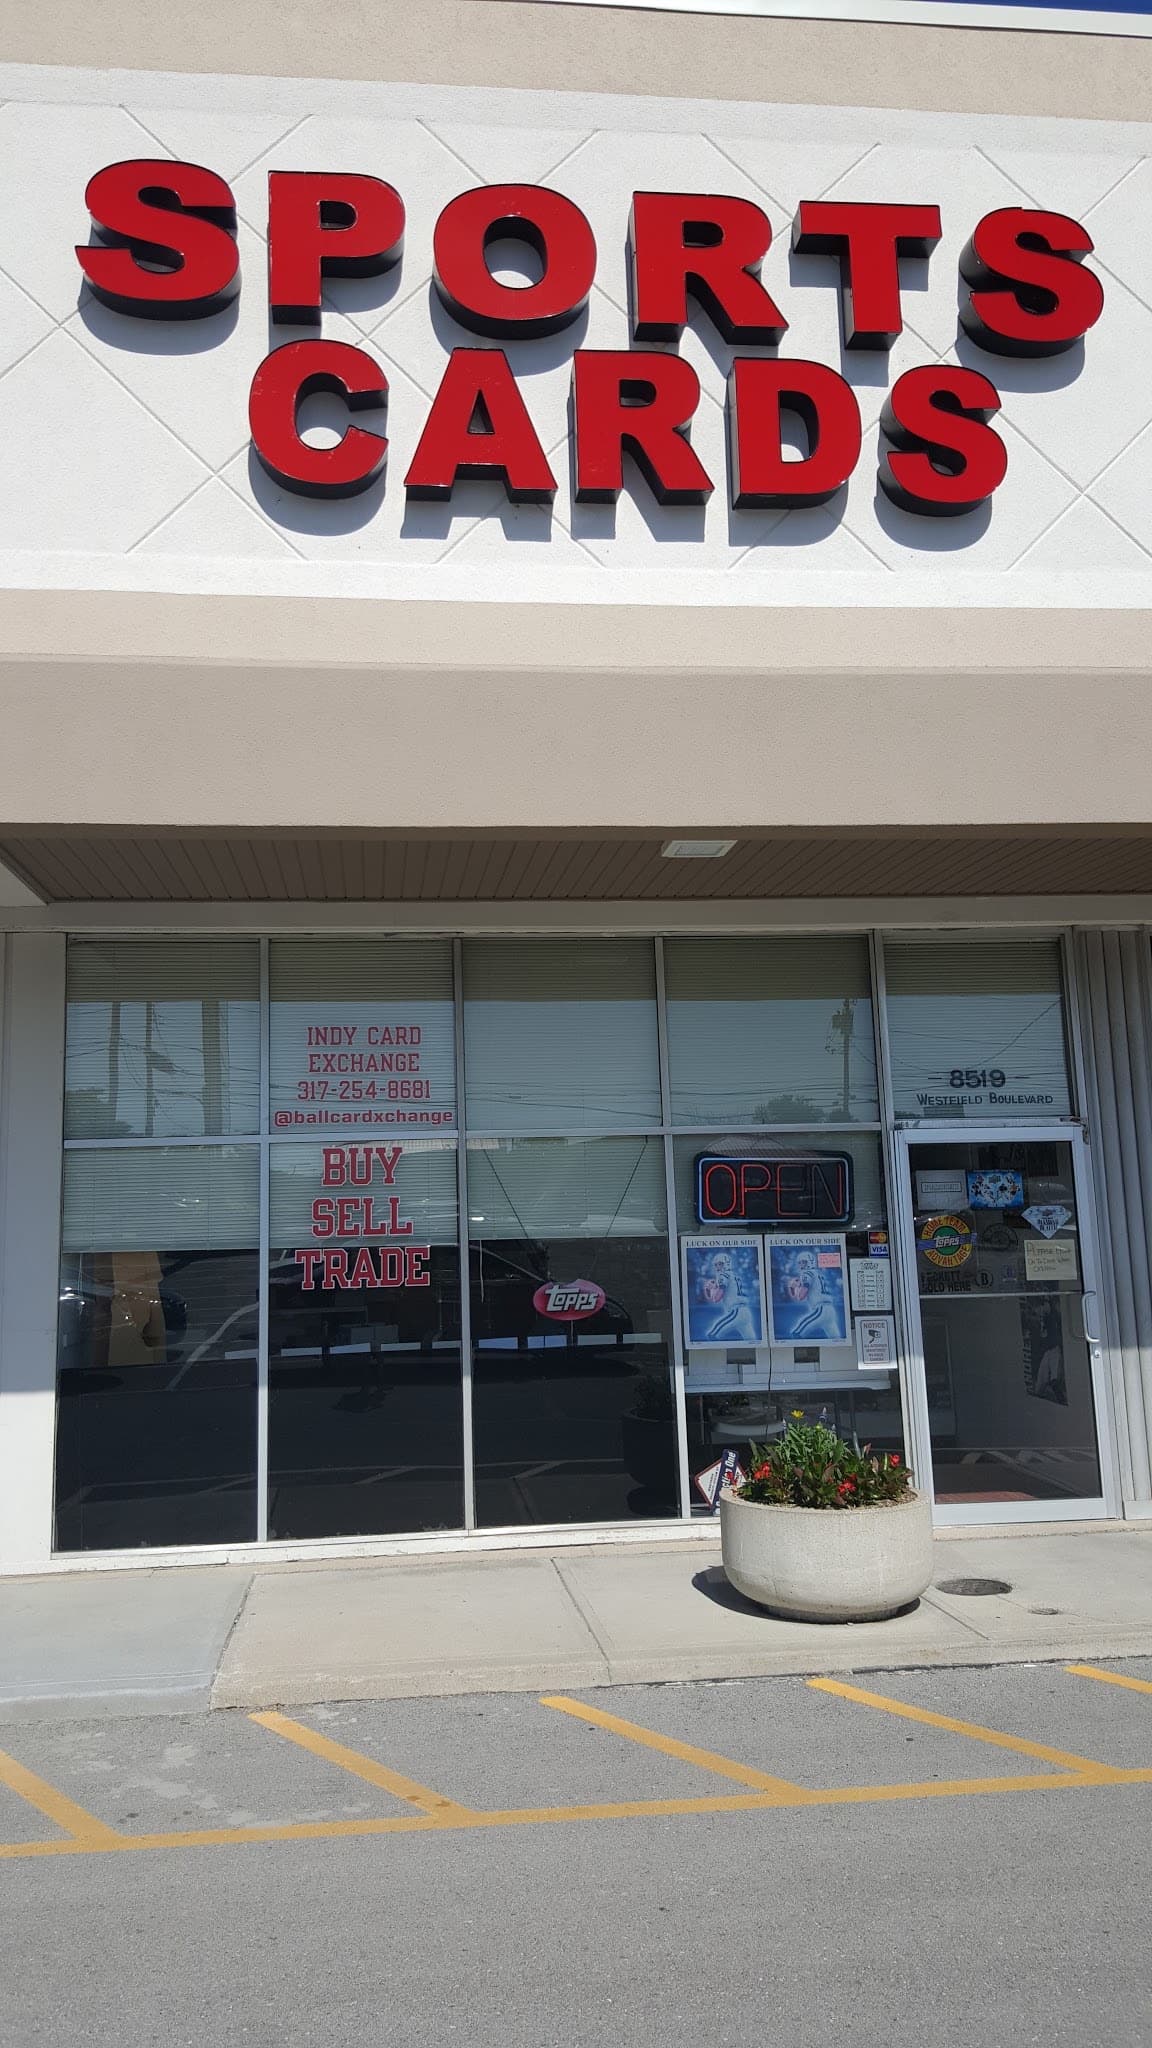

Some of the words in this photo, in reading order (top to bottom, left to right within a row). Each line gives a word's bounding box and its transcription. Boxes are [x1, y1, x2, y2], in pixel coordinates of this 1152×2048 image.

[74, 159, 1104, 357] SPORTS
[249, 339, 1008, 514] CARDS
[307, 1026, 358, 1046] INDY
[367, 1026, 422, 1046] CARD
[308, 1053, 421, 1073] EXCHANGE
[950, 1069, 1006, 1088] 8519
[297, 1079, 431, 1101] 317-254-8681
[274, 1109, 454, 1127] @ballcardxchange
[321, 1147, 403, 1187] BUY
[705, 1164, 843, 1216] OPEN
[311, 1197, 414, 1238] SELL
[295, 1247, 431, 1290] TRADE
